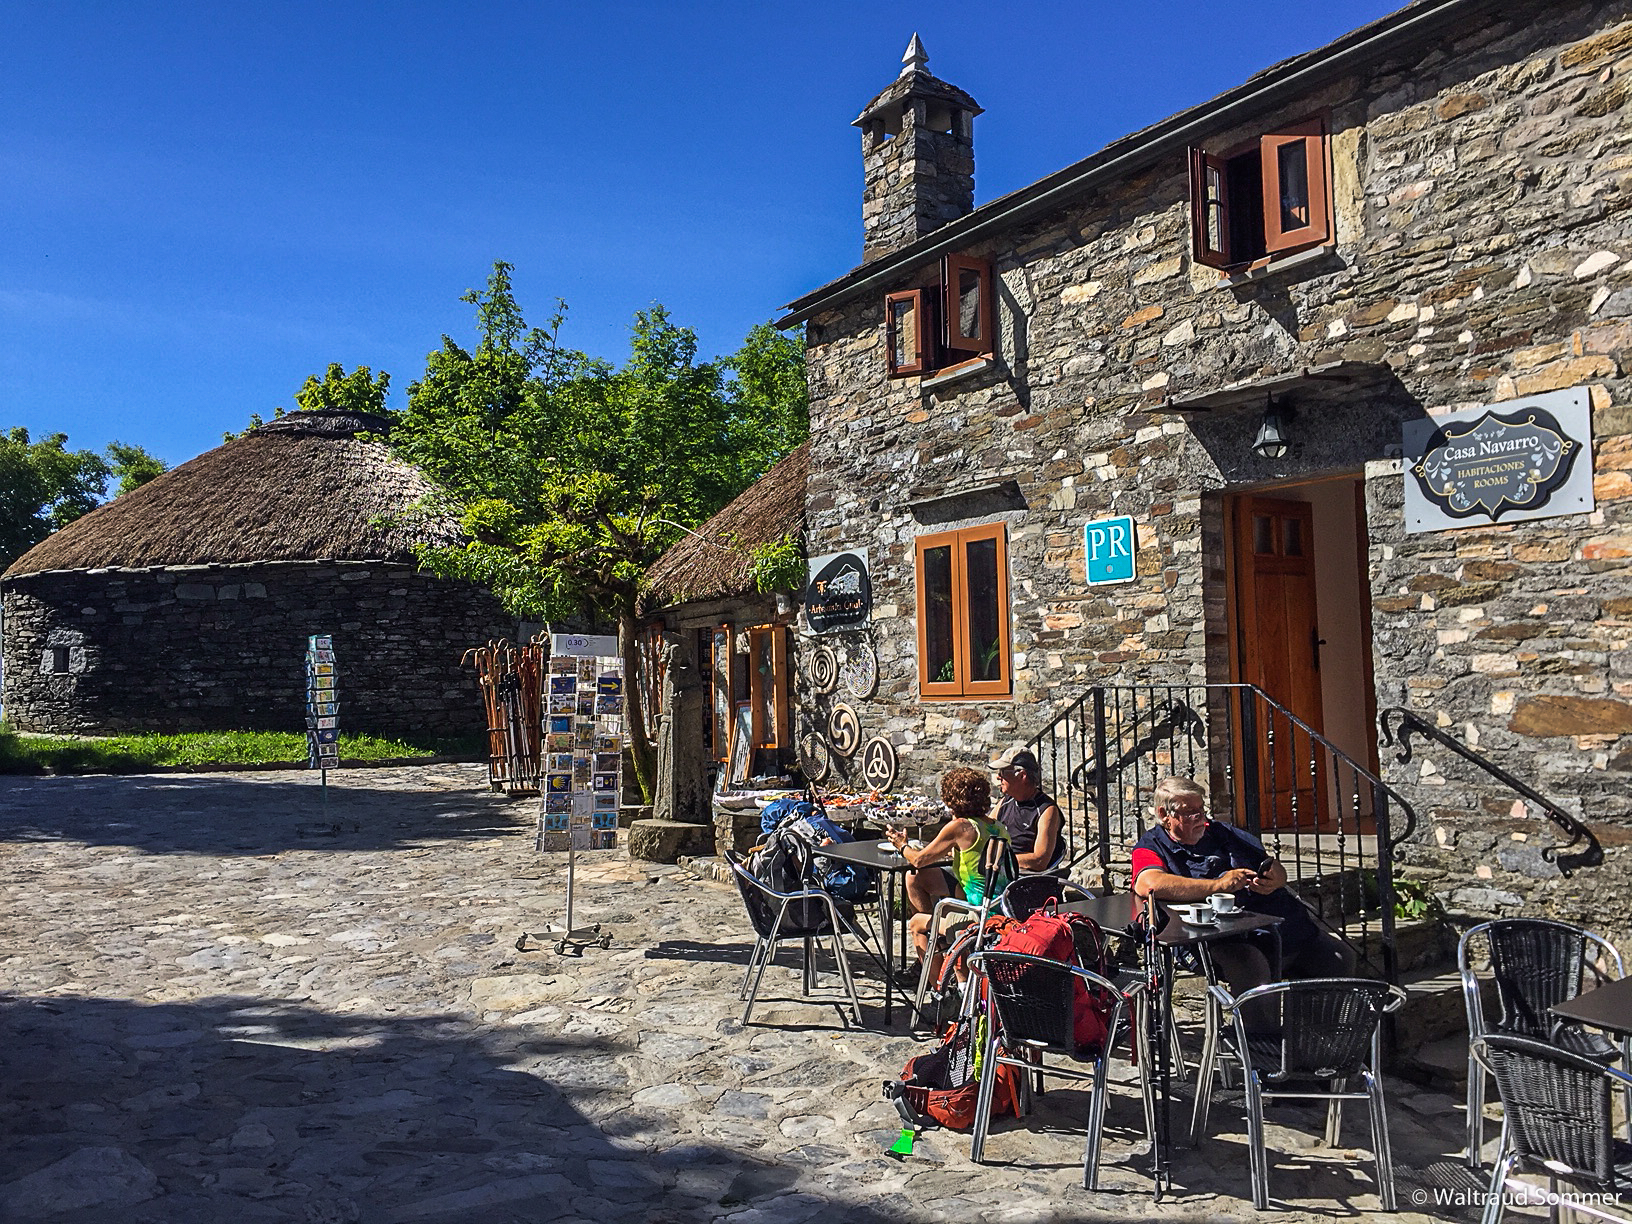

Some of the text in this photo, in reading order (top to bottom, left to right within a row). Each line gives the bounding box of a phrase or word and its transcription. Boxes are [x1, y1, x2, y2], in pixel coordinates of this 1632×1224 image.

[1443, 435, 1539, 461] Casa Navarro
[1457, 460, 1525, 479] HABITACIONES
[1473, 475, 1509, 489] ROOMS
[1088, 525, 1130, 561] PR
